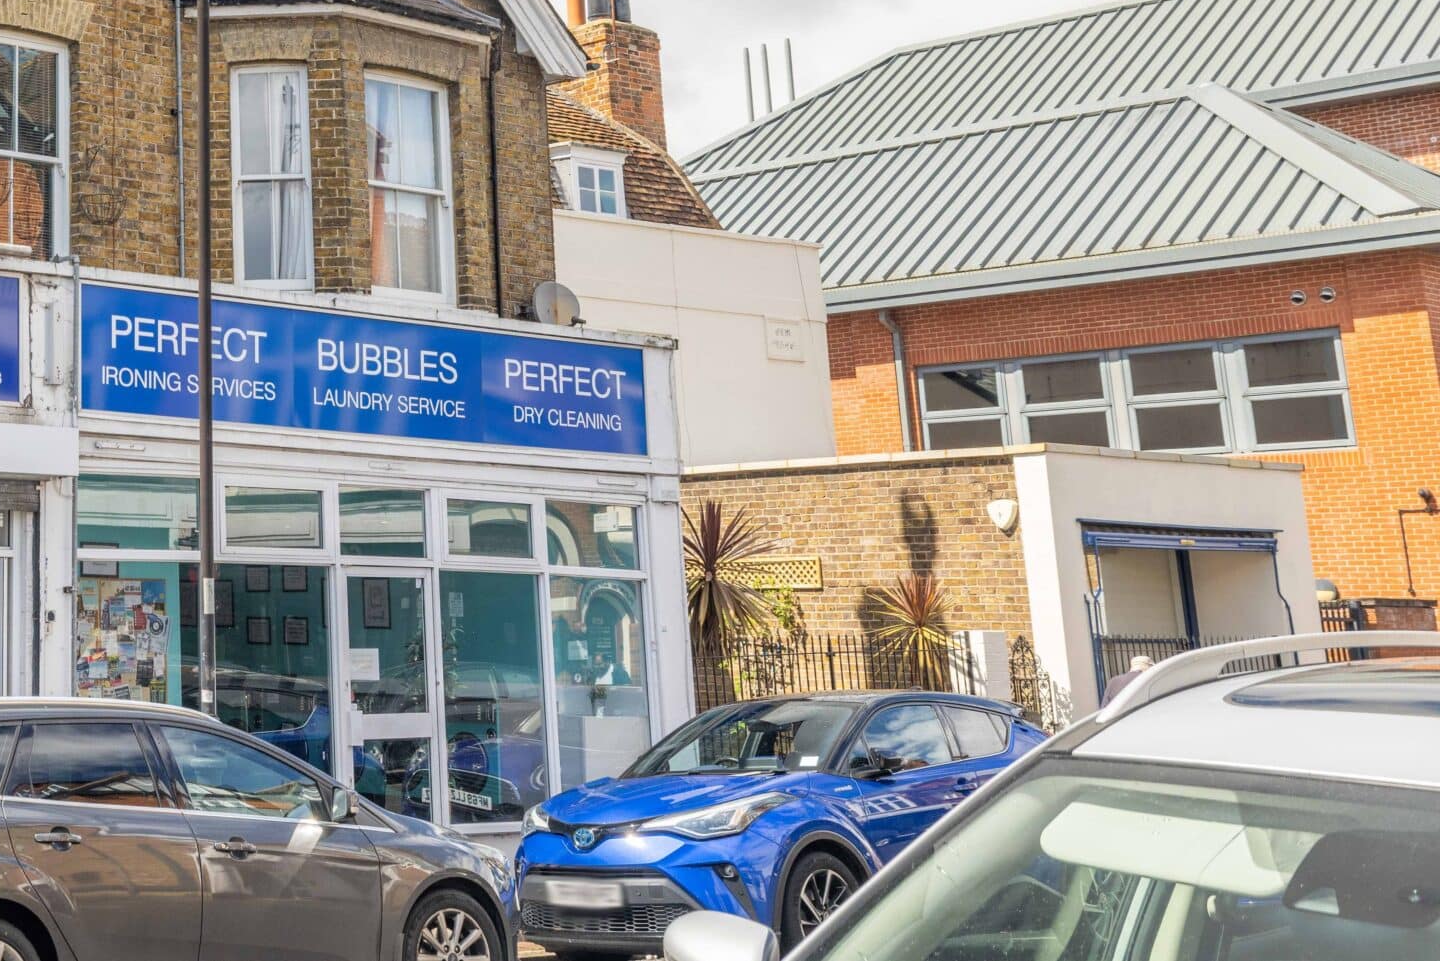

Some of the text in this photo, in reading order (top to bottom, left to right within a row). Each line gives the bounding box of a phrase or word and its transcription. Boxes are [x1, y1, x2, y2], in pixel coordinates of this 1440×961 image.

[111, 314, 267, 364] PERFECT
[317, 338, 458, 385] BUBBLES
[504, 358, 627, 400] PERFECT
[102, 365, 276, 401] IRONING SRVICES
[313, 387, 466, 419] LAUNDRY SERVICE
[513, 405, 623, 432] DRY CLEANING
